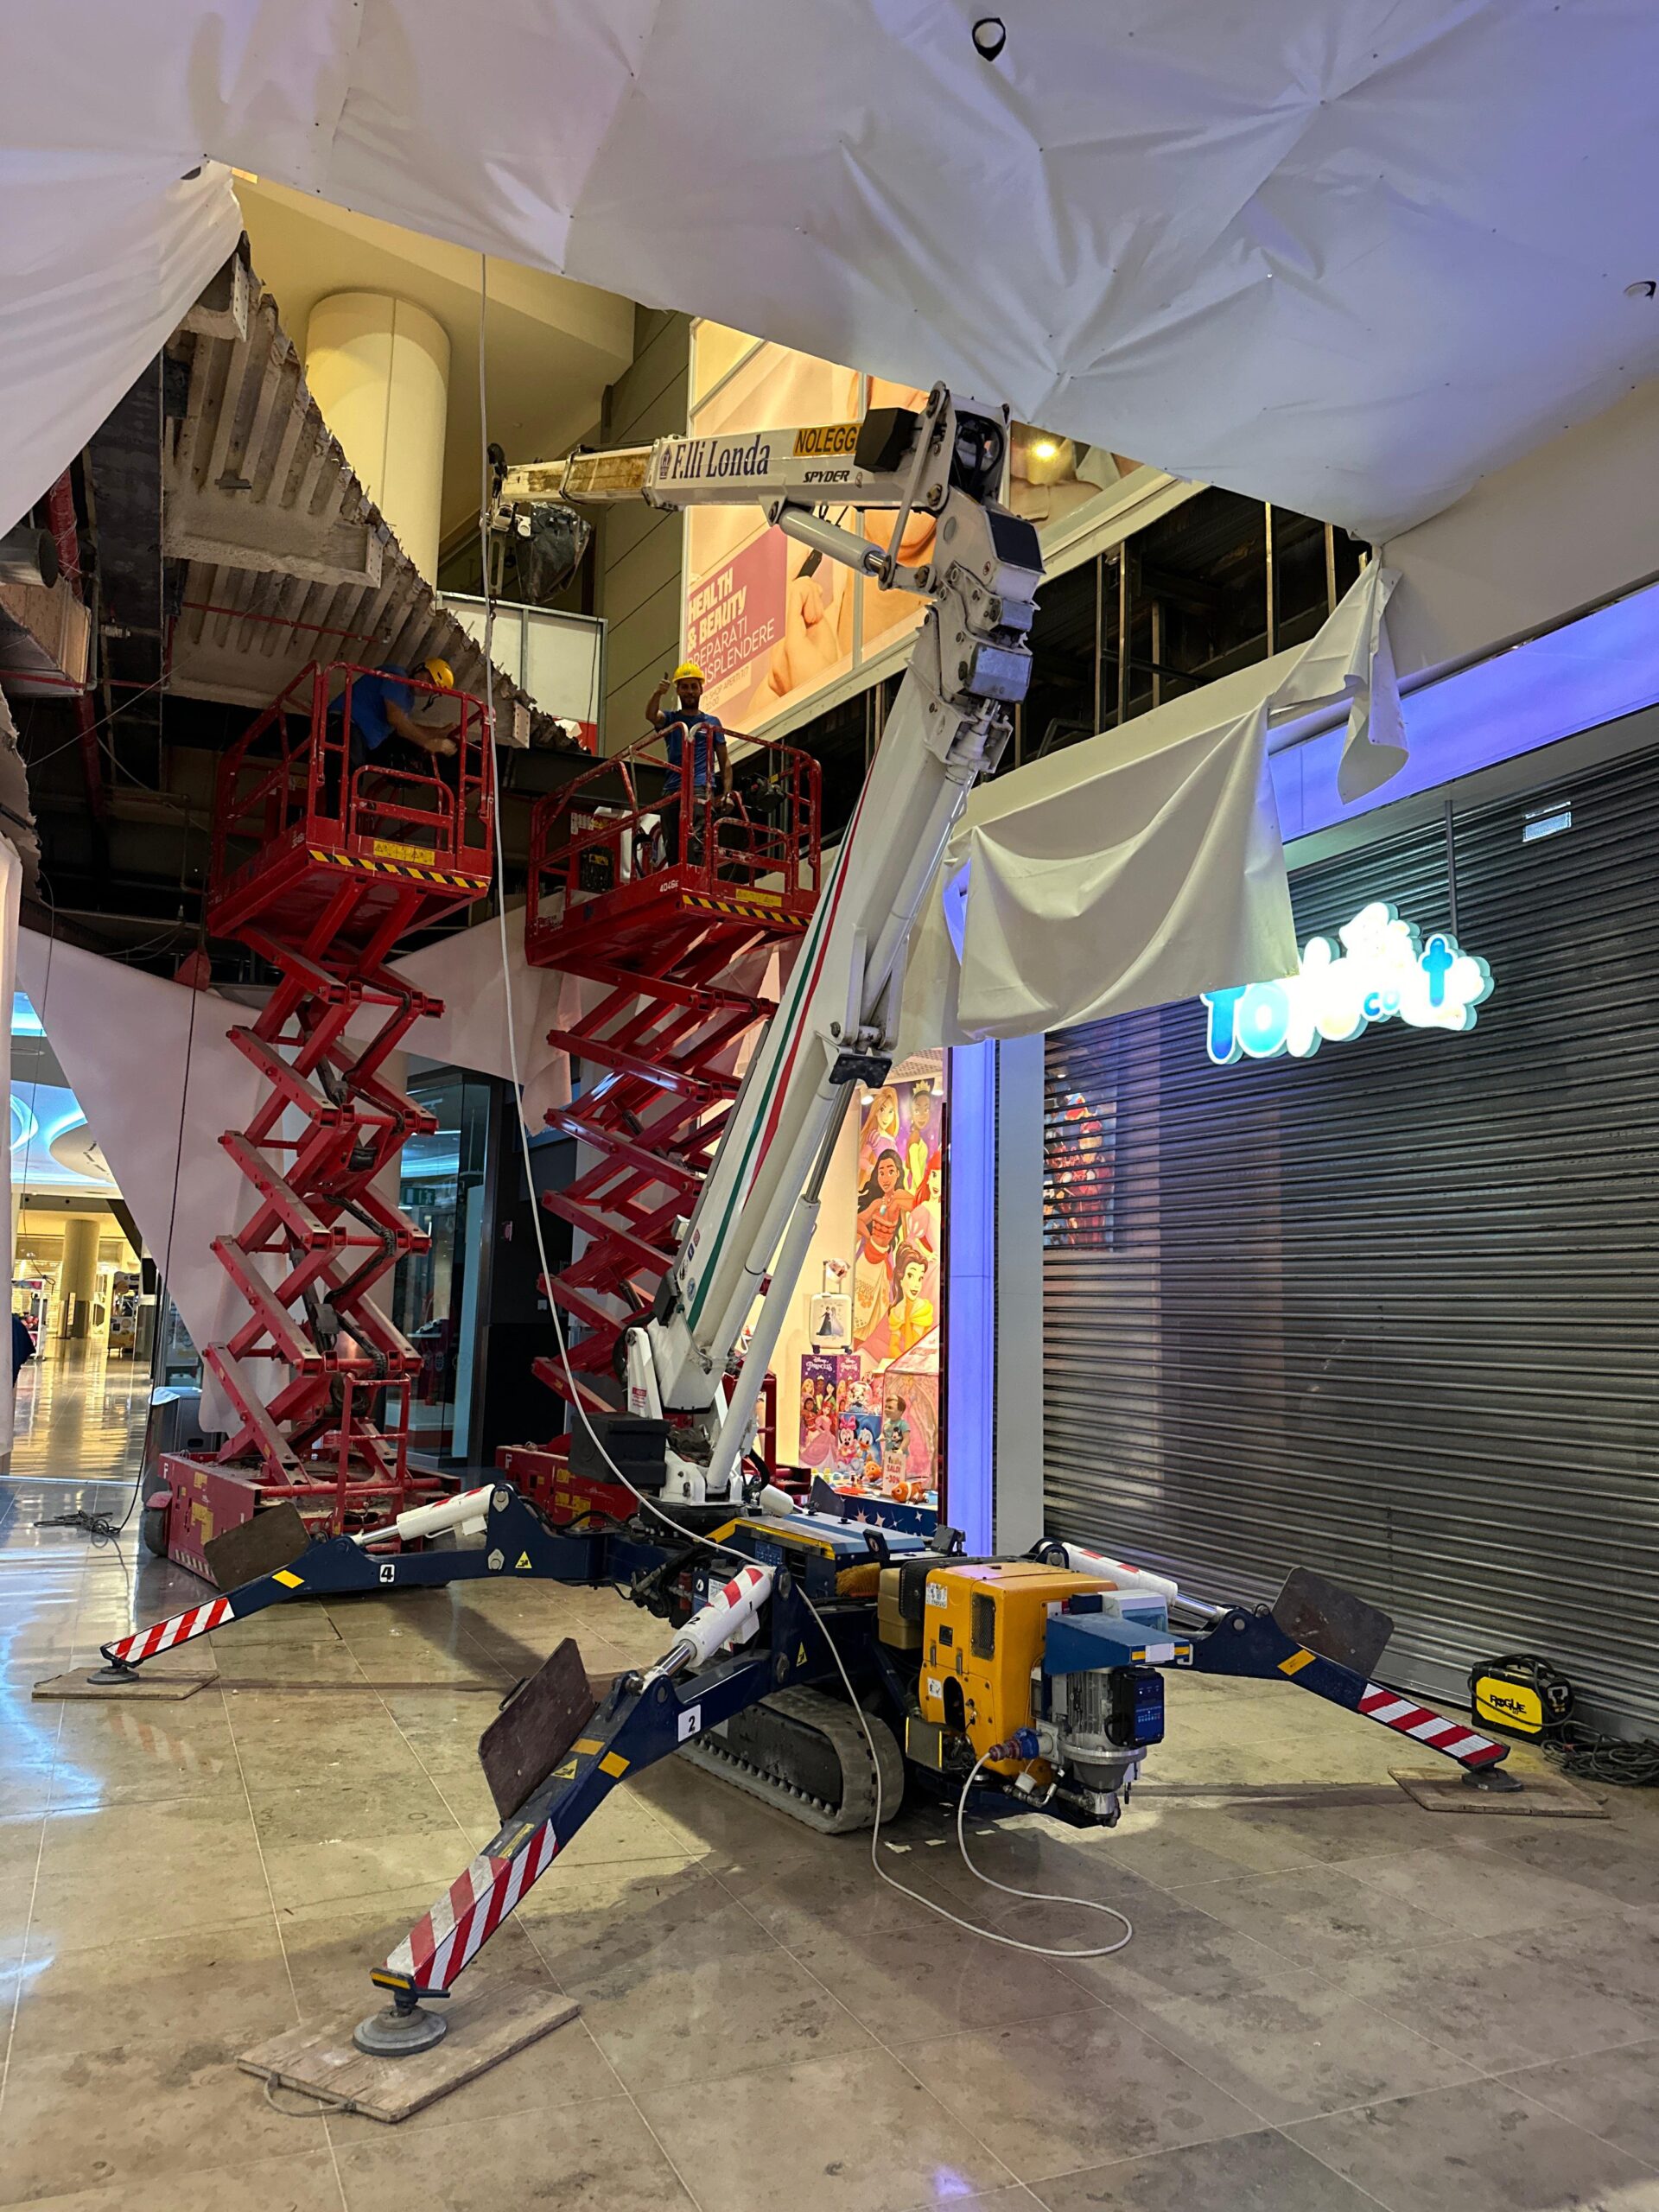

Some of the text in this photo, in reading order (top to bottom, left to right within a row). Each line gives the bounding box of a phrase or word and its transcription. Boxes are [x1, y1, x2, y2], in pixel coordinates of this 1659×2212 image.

[671, 435, 771, 480] F.lli Londa
[803, 470, 850, 484] SPYDER
[688, 567, 733, 626] HEALTH
[699, 585, 747, 645] BEAUTY
[701, 618, 774, 686] ISPLENDERE
[381, 1567, 394, 1580] 4
[688, 1715, 696, 1733] 2
